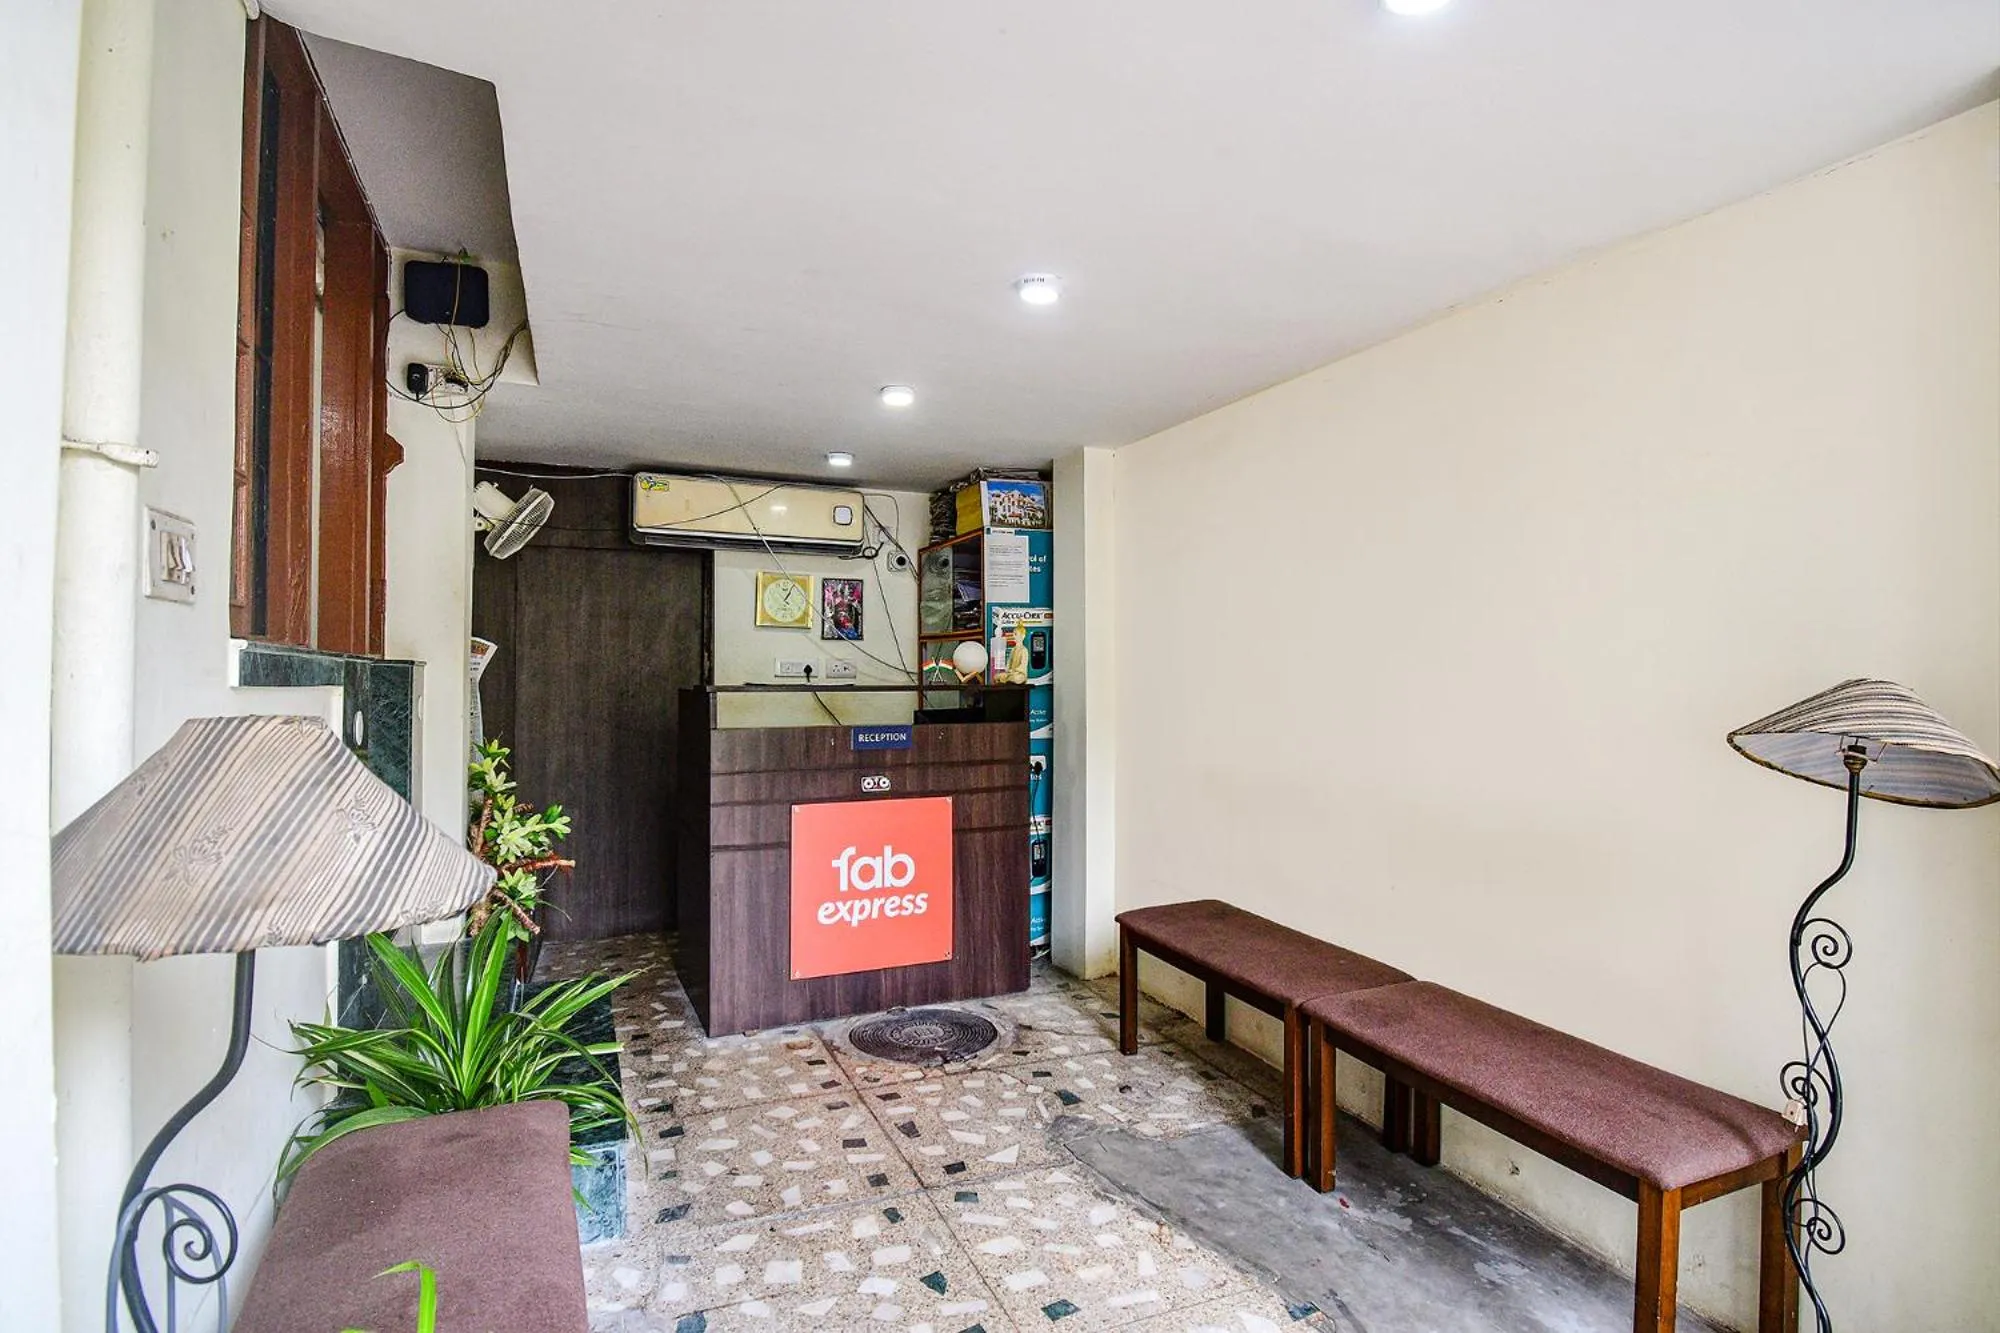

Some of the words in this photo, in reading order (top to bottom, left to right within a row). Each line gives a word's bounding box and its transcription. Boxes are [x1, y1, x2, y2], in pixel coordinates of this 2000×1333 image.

[858, 733, 907, 742] RECEPTION
[863, 775, 891, 790] OYO
[831, 844, 916, 892] fab
[816, 892, 929, 928] express
